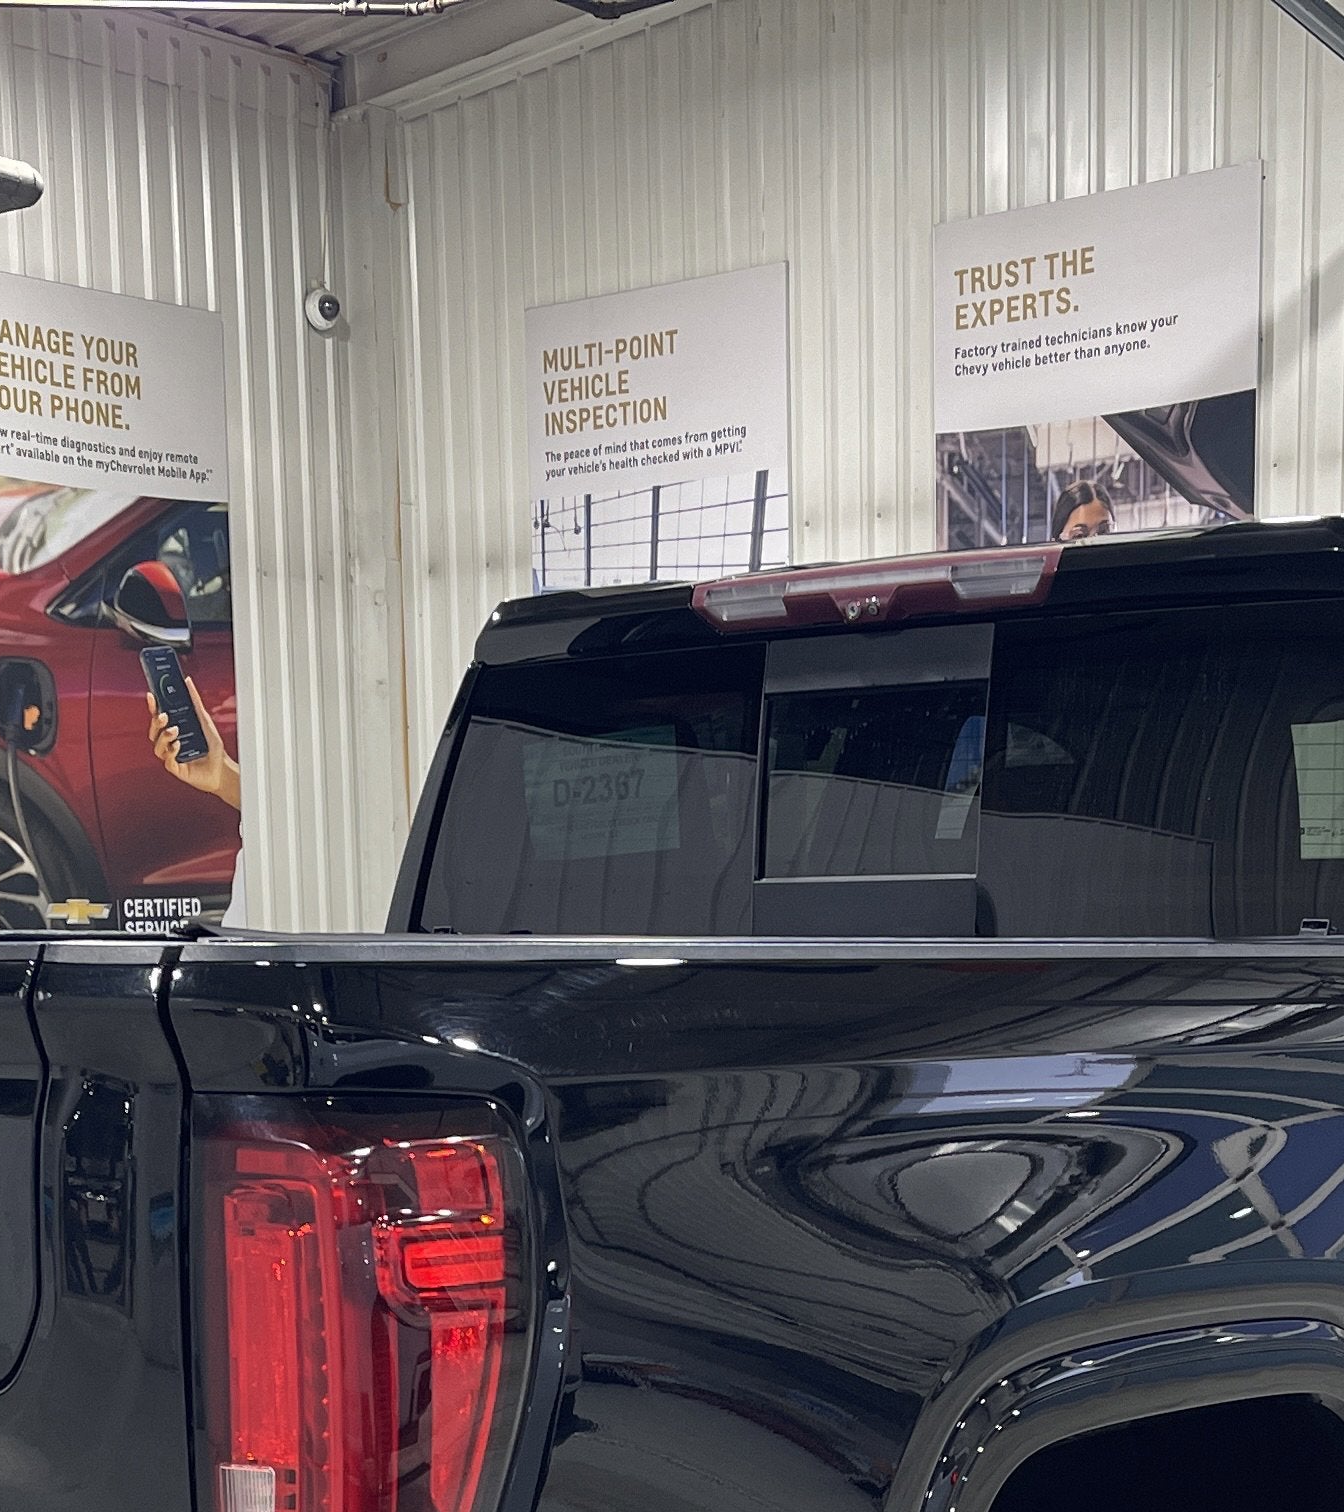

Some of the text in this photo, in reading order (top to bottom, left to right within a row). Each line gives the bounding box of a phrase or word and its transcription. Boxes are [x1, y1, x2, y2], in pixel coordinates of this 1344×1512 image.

[954, 246, 1095, 297] TRUST THE
[955, 287, 1079, 330] EXPERTS.
[81, 334, 138, 368] YOUR
[543, 329, 678, 374] MULTI-POINT
[954, 313, 1178, 360] Factory trained technicians know your
[954, 338, 1151, 377] Chevy vehicle better than anyone.
[82, 367, 141, 400] FROM
[543, 370, 629, 405] VEHICLE
[50, 394, 131, 430] PHONE.
[545, 396, 668, 436] INSPECTION
[11, 427, 58, 447] real-time
[60, 435, 116, 456] diagnostics
[118, 443, 136, 458] and
[138, 448, 163, 465] enjoy
[165, 452, 198, 465] remote
[16, 446, 60, 463] available
[62, 455, 75, 466] on
[77, 454, 93, 469] the
[95, 459, 156, 477] myChevrolet
[158, 466, 187, 480] Mobile
[545, 425, 747, 464] The peace of mind that comes from getting
[545, 467, 566, 481] your
[568, 459, 607, 476] vehicle's
[609, 456, 638, 471] health
[640, 450, 680, 467] checked
[682, 446, 704, 461] with
[706, 447, 713, 457] a
[123, 897, 201, 918] CERTIFIED
